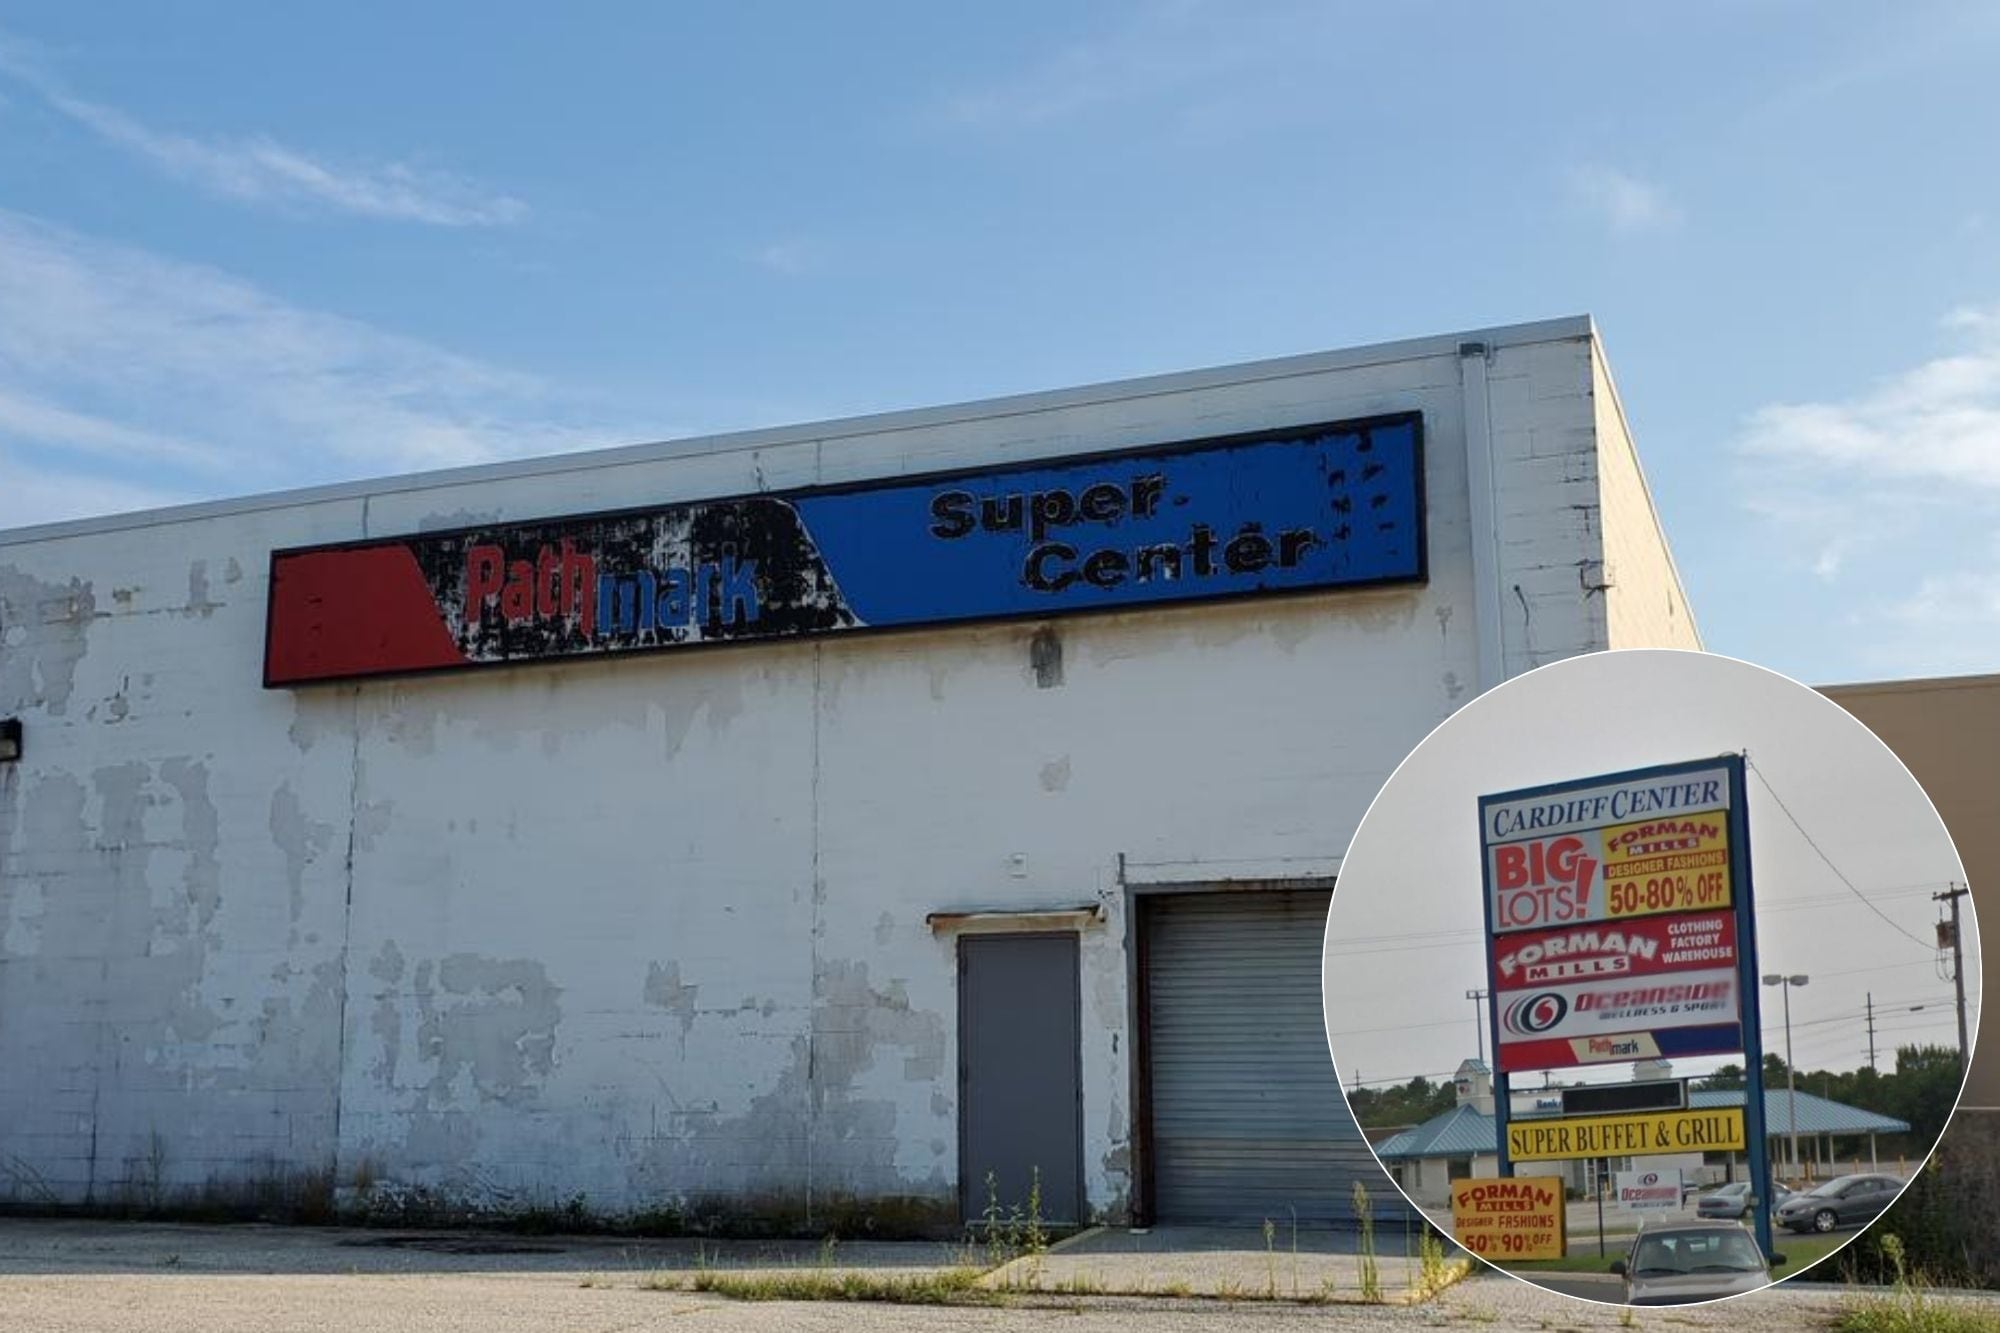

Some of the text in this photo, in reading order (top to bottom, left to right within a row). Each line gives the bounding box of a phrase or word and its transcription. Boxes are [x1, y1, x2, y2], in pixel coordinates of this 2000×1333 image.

[929, 471, 1167, 540] Super
[1020, 523, 1317, 592] Center
[466, 537, 760, 638] Pathmark
[1493, 780, 1720, 837] CARDIFF CENTER
[1607, 820, 1720, 853] FORMAN
[1628, 837, 1698, 856] MILLS
[1495, 835, 1587, 890] BIG
[1608, 852, 1724, 879] DESIGNER FASHIONS
[1497, 856, 1598, 929] LOTS!
[1609, 872, 1724, 915] 50-80% OFF
[1667, 919, 1724, 936] CLOTHING
[1498, 931, 1660, 978] FORMAN
[1671, 933, 1720, 950] FACTORY
[1528, 956, 1628, 980] MILLS
[1662, 947, 1733, 964] WAREHOUSE
[1589, 1038, 1639, 1055] Pathmark
[1511, 1116, 1741, 1155] SUPER BUFFET & GRILL
[1457, 1184, 1554, 1209] FORMAN
[1478, 1201, 1532, 1211] MILLS
[1498, 1214, 1554, 1229] FASHIONS
[1533, 1233, 1553, 1245] OFF
